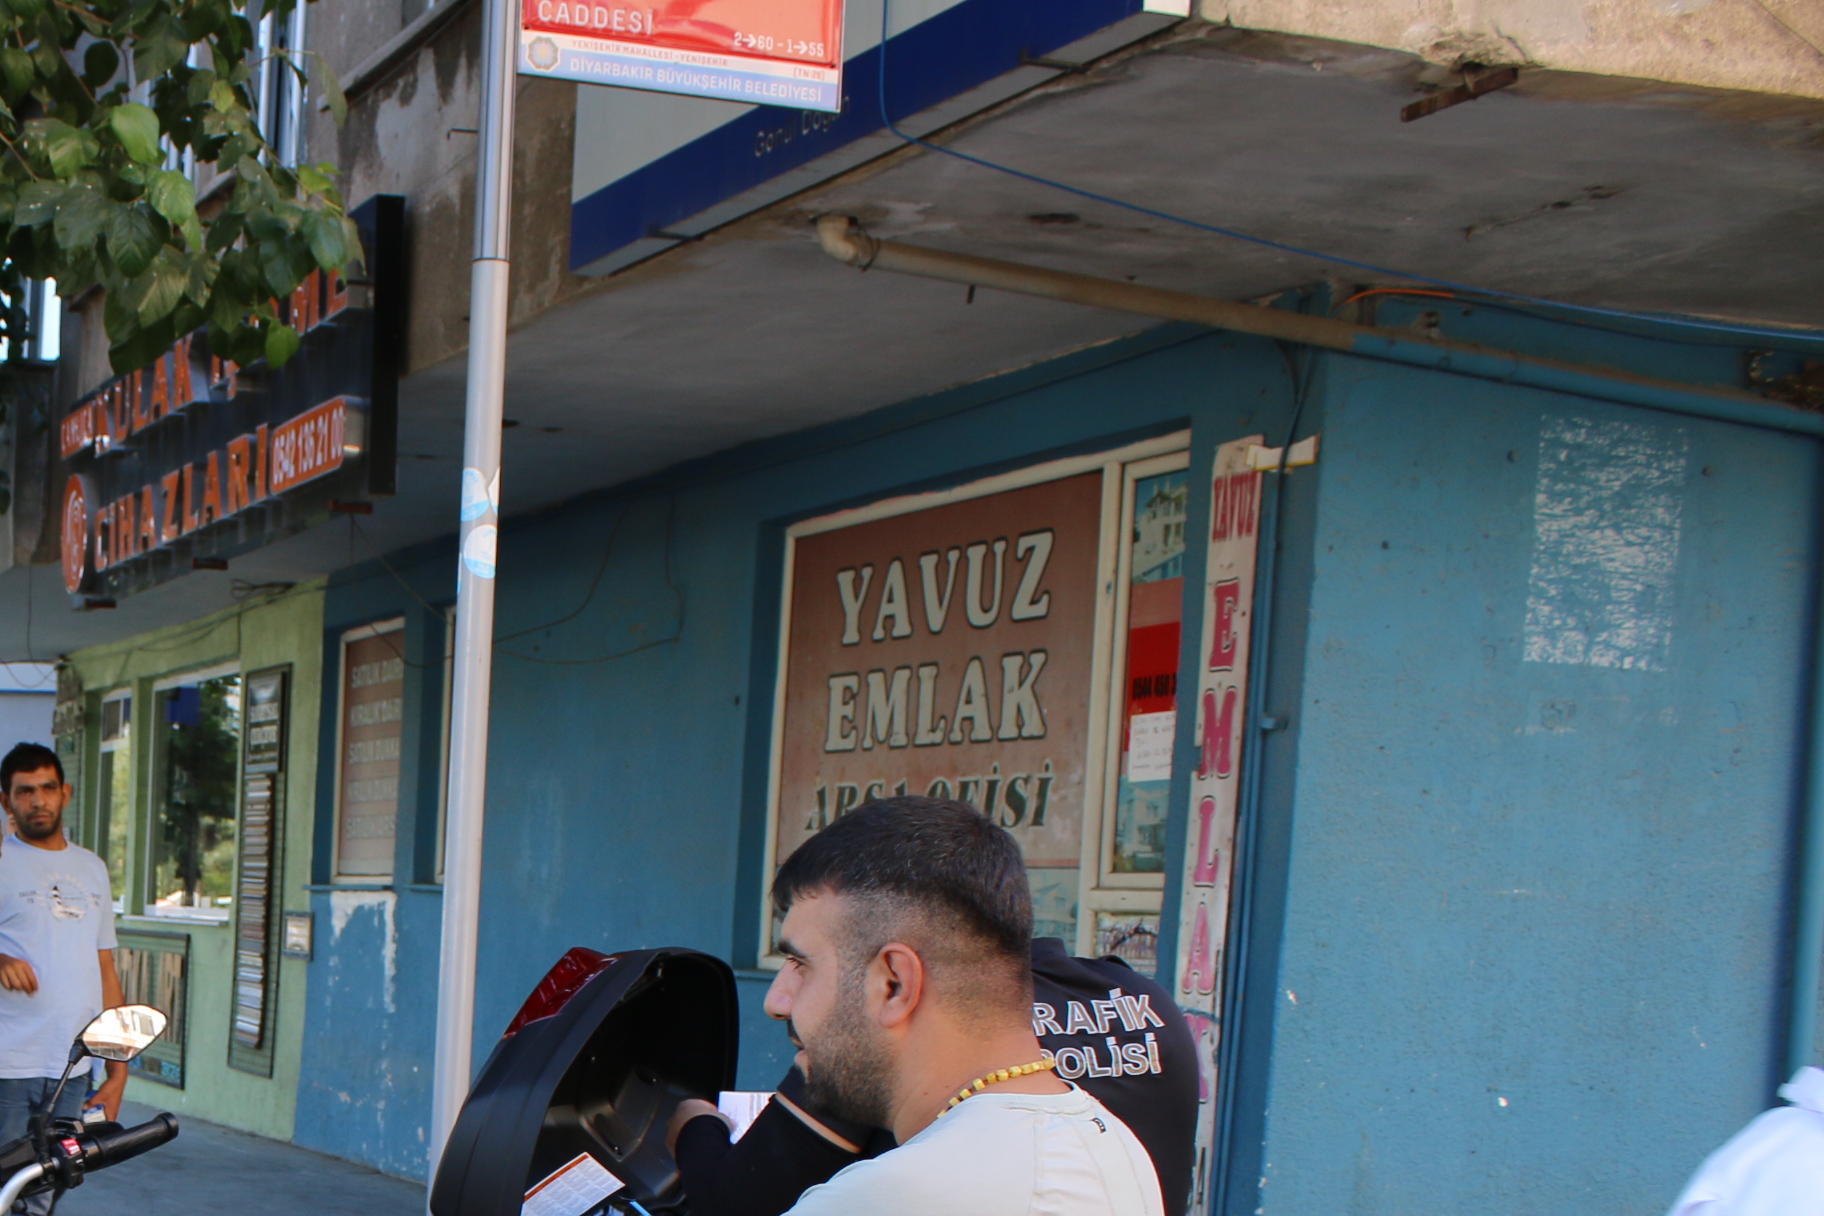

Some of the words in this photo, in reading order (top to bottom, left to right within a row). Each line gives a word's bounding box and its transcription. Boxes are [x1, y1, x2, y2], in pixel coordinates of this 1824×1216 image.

[537, 0, 653, 35] CADDESİ
[570, 57, 654, 80] DİYARBAKIR
[657, 65, 742, 92] BÜYÜKŞEHİR
[745, 79, 823, 102] BELEDİYESİ
[95, 424, 269, 572] CİHAZLARI
[836, 528, 1055, 647] YAVUZ
[824, 650, 1048, 753] EMLAK
[1032, 988, 1166, 1036] RAFİK
[1040, 1032, 1163, 1080] OLİSİ
